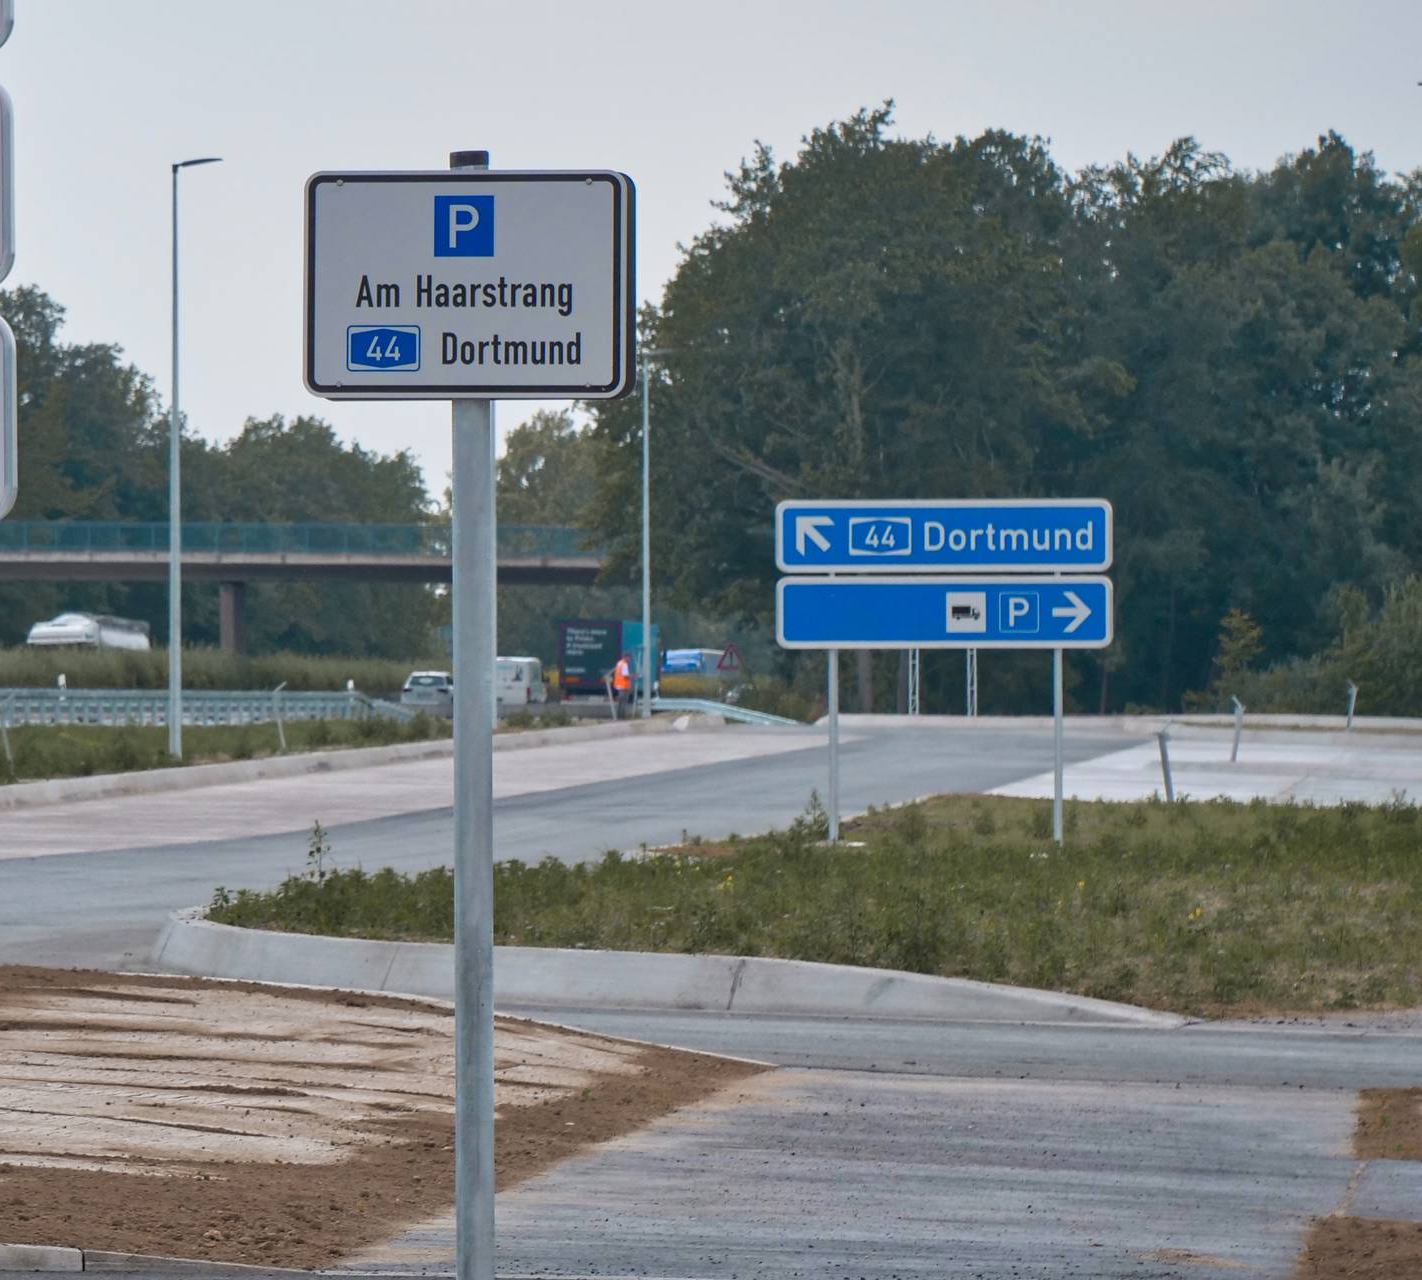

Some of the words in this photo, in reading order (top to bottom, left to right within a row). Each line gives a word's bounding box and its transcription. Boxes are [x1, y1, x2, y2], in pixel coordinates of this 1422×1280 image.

[449, 204, 480, 248] P
[355, 275, 401, 308] Am
[416, 274, 573, 317] Haarstrang
[365, 335, 401, 361] 44
[441, 332, 582, 365] Dortmund
[864, 525, 896, 548] 44
[923, 520, 1094, 551] Dortmund
[1009, 597, 1029, 627] P
